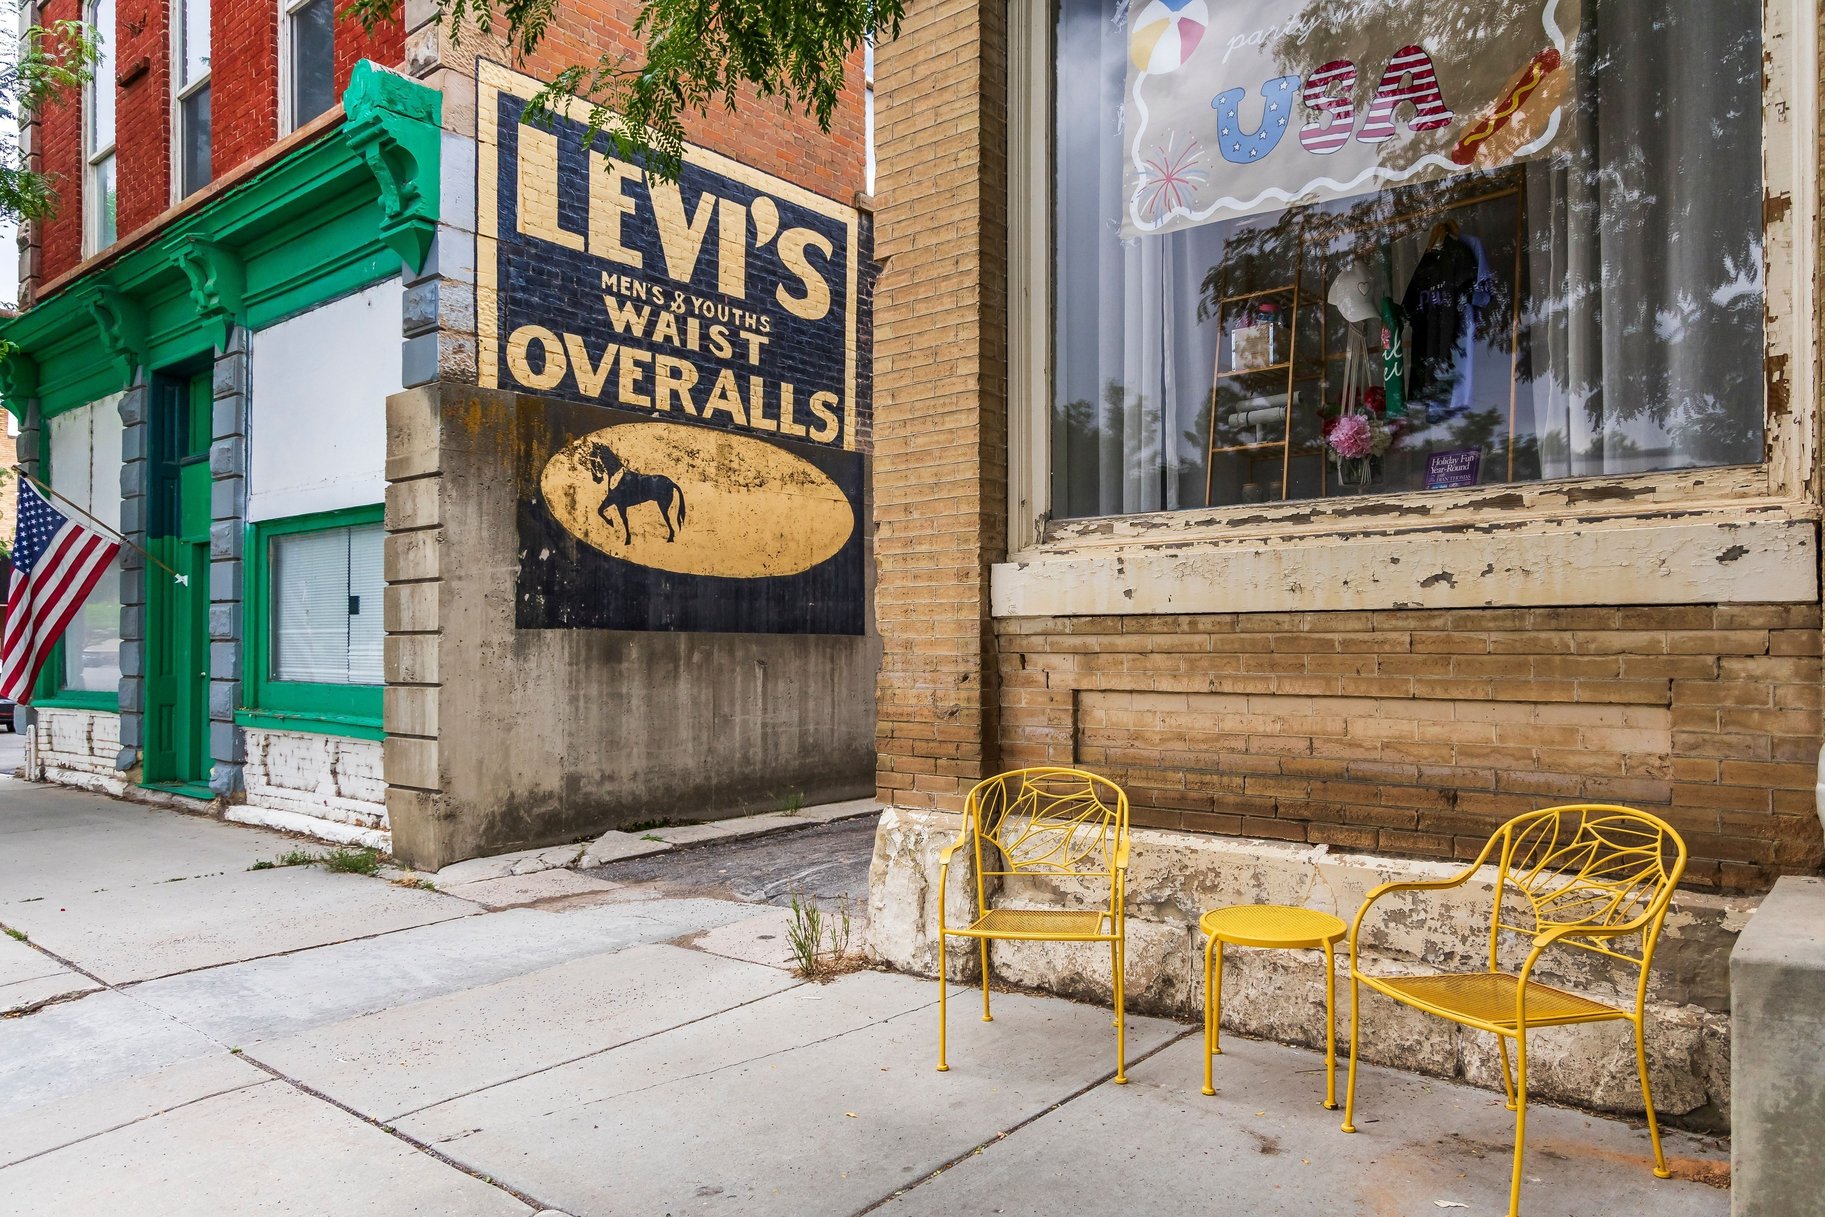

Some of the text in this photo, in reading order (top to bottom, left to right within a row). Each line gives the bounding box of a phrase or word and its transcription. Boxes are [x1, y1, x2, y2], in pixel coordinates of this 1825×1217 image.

[1221, 12, 1322, 64] party
[1211, 44, 1454, 164] USA
[516, 122, 833, 321] LEVI'S
[601, 270, 771, 333] MEN'S & YOUTHS
[602, 294, 770, 366] WAIST
[506, 324, 840, 443] OVERALLS
[1431, 454, 1475, 467] Holiday Fun
[1431, 461, 1470, 474] Year-Round
